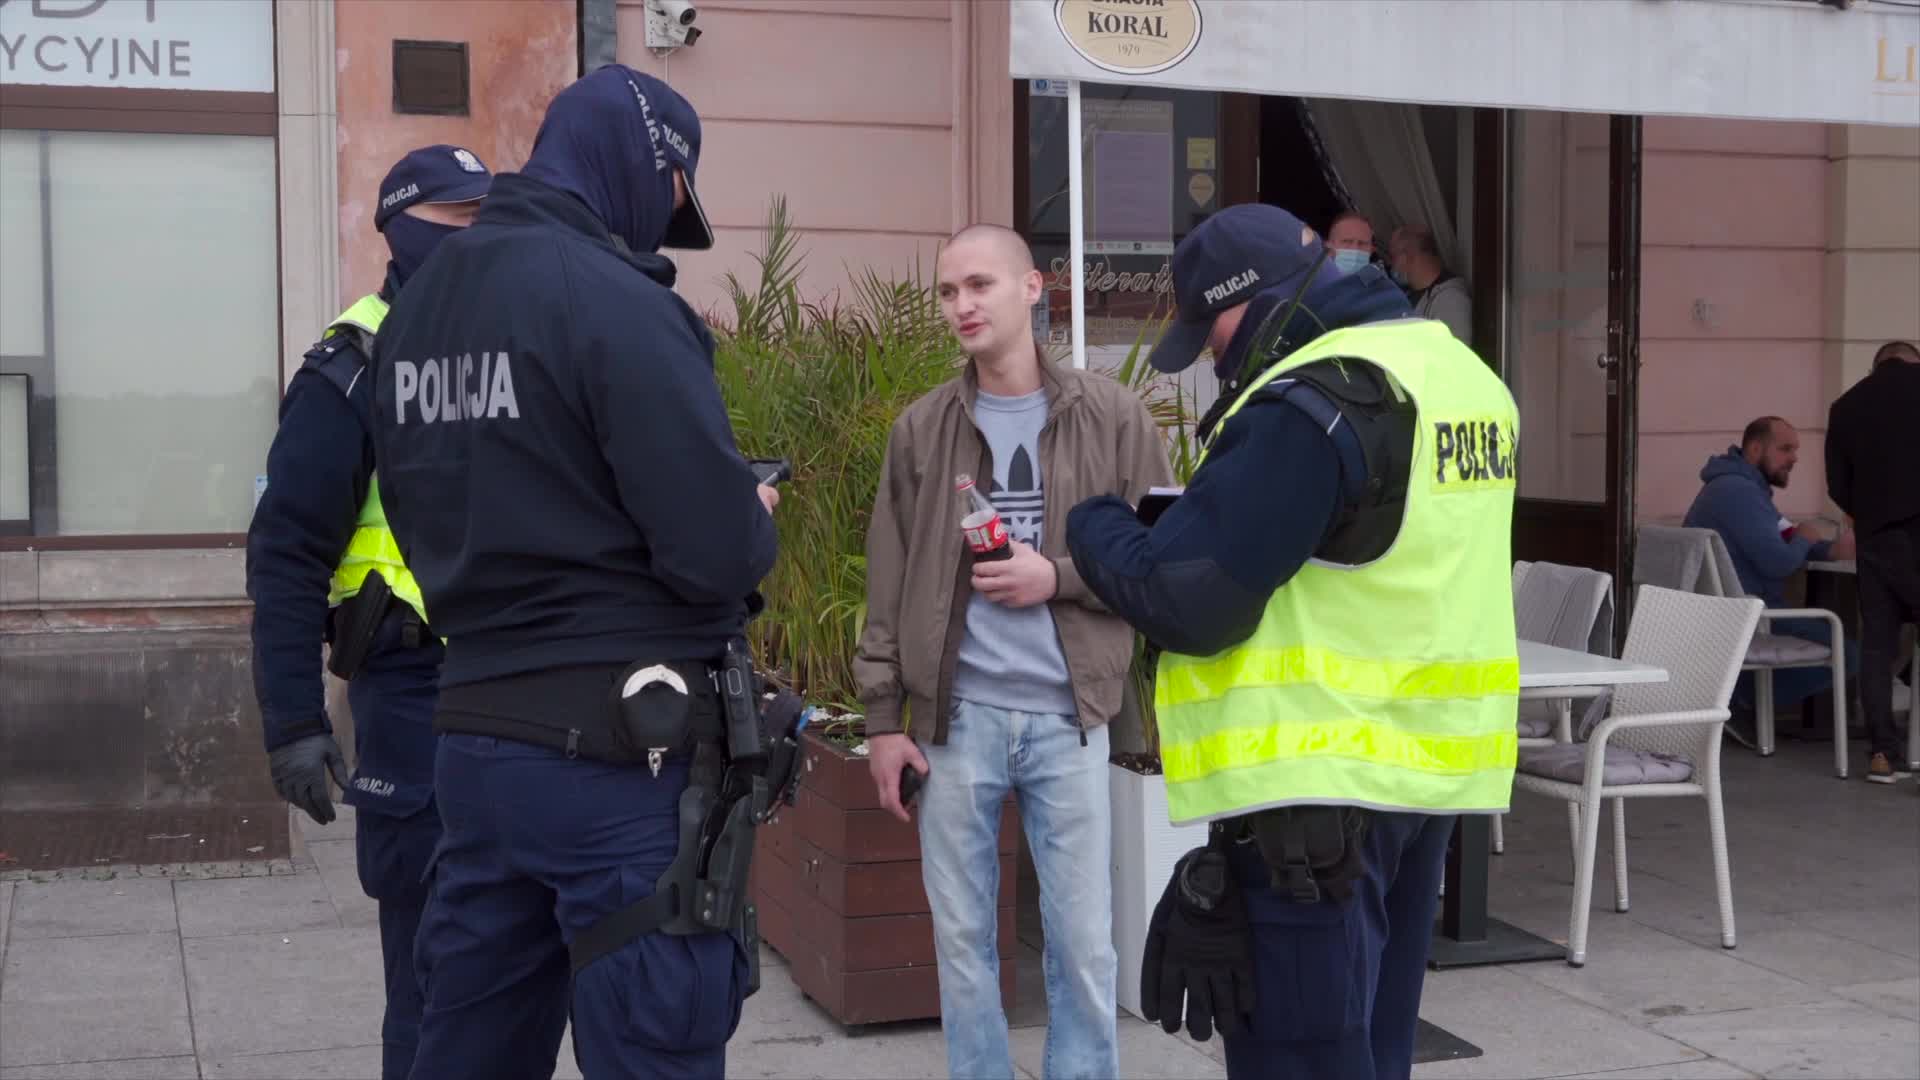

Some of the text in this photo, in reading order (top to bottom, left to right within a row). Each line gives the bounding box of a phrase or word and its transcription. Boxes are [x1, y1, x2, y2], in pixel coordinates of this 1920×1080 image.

[1088, 11, 1168, 38] KORAL
[0, 34, 191, 80] YCYJNE
[1117, 43, 1141, 56] 1979
[382, 183, 420, 209] POLICJA
[1203, 268, 1260, 305] POLICJA
[394, 351, 520, 425] POLICJA
[1433, 420, 1517, 484] POLICJ
